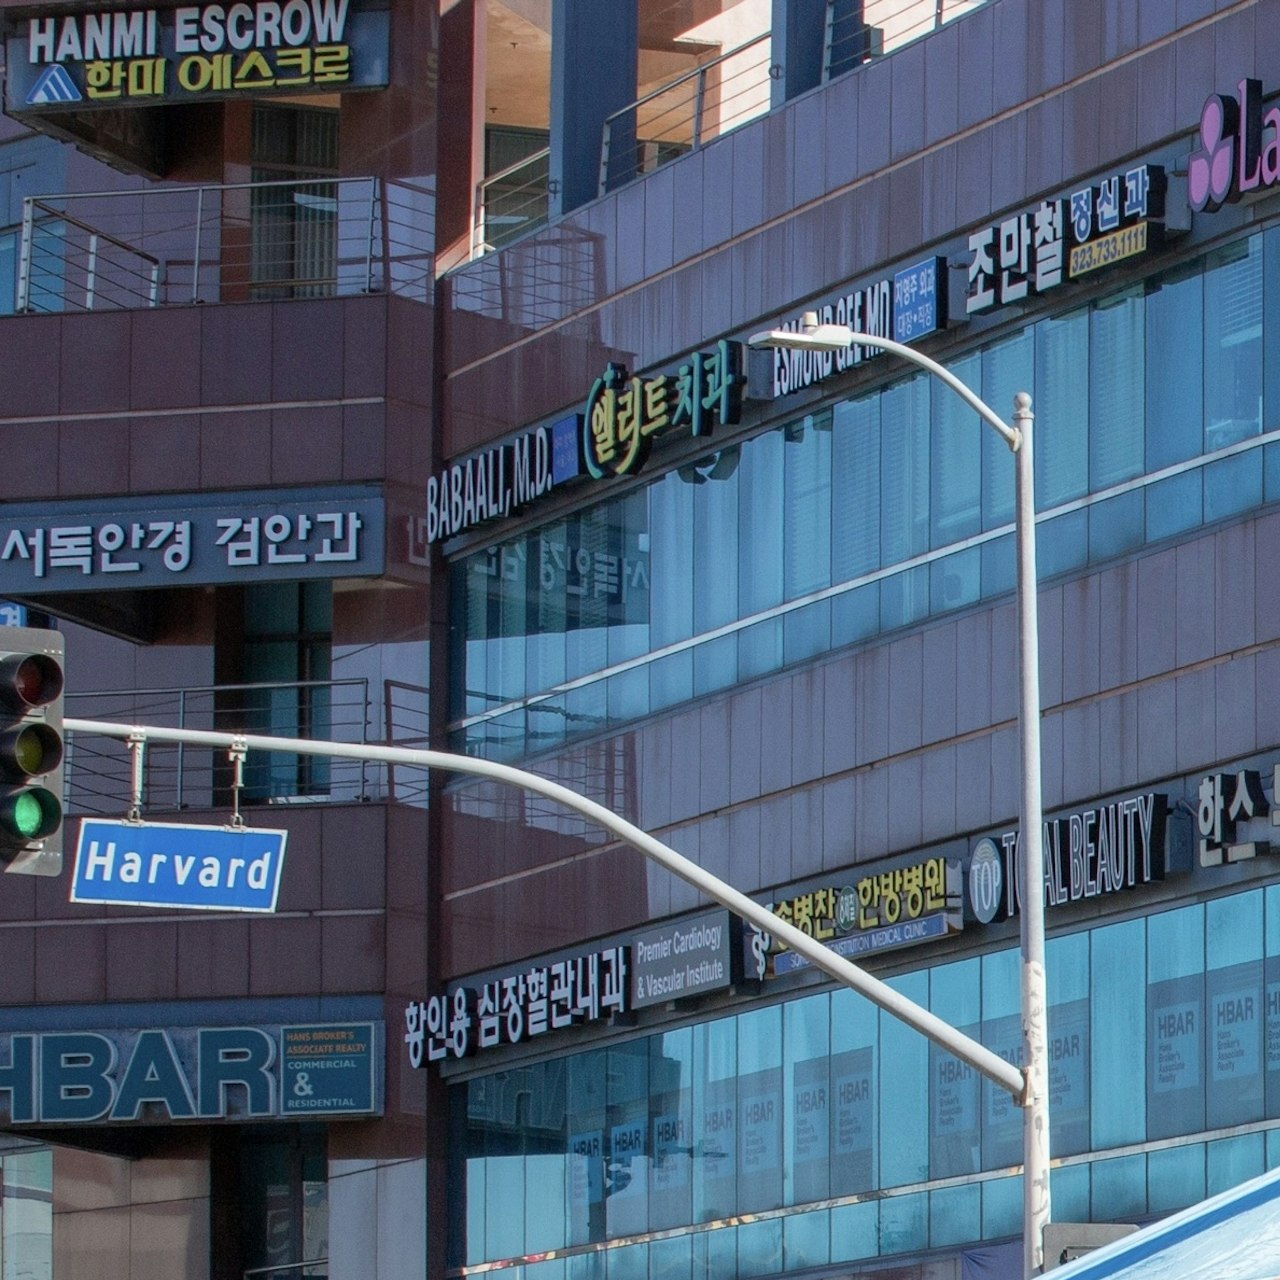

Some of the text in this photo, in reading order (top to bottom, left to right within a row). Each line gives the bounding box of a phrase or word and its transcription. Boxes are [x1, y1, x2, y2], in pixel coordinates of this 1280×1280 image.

[29, 0, 349, 64] HANMI ESCROW
[86, 45, 350, 99] 한미 에스크로
[966, 164, 1150, 314] 조만철 정신과
[1072, 225, 1147, 273] 323.733.1111
[590, 339, 734, 475] 엘리트 치과
[427, 445, 511, 543] BABAALI,
[513, 427, 552, 508] M.D.
[1, 512, 362, 578] 서독안경 검안과
[84, 840, 271, 890] Harvard
[1069, 793, 1155, 902] BEAUTY
[857, 858, 946, 930] 한방병원
[971, 860, 1001, 914] TOP
[637, 924, 722, 965] Premier Cardiology
[478, 946, 626, 1048] 심장혈관내과
[637, 959, 723, 999] & Vascular Institute
[1158, 1010, 1194, 1039] HBAR
[1217, 996, 1254, 1027] HBAR
[287, 1060, 358, 1070] COMMERCIAL
[293, 1072, 314, 1096] &
[287, 1098, 356, 1108] RESIDENTIAL
